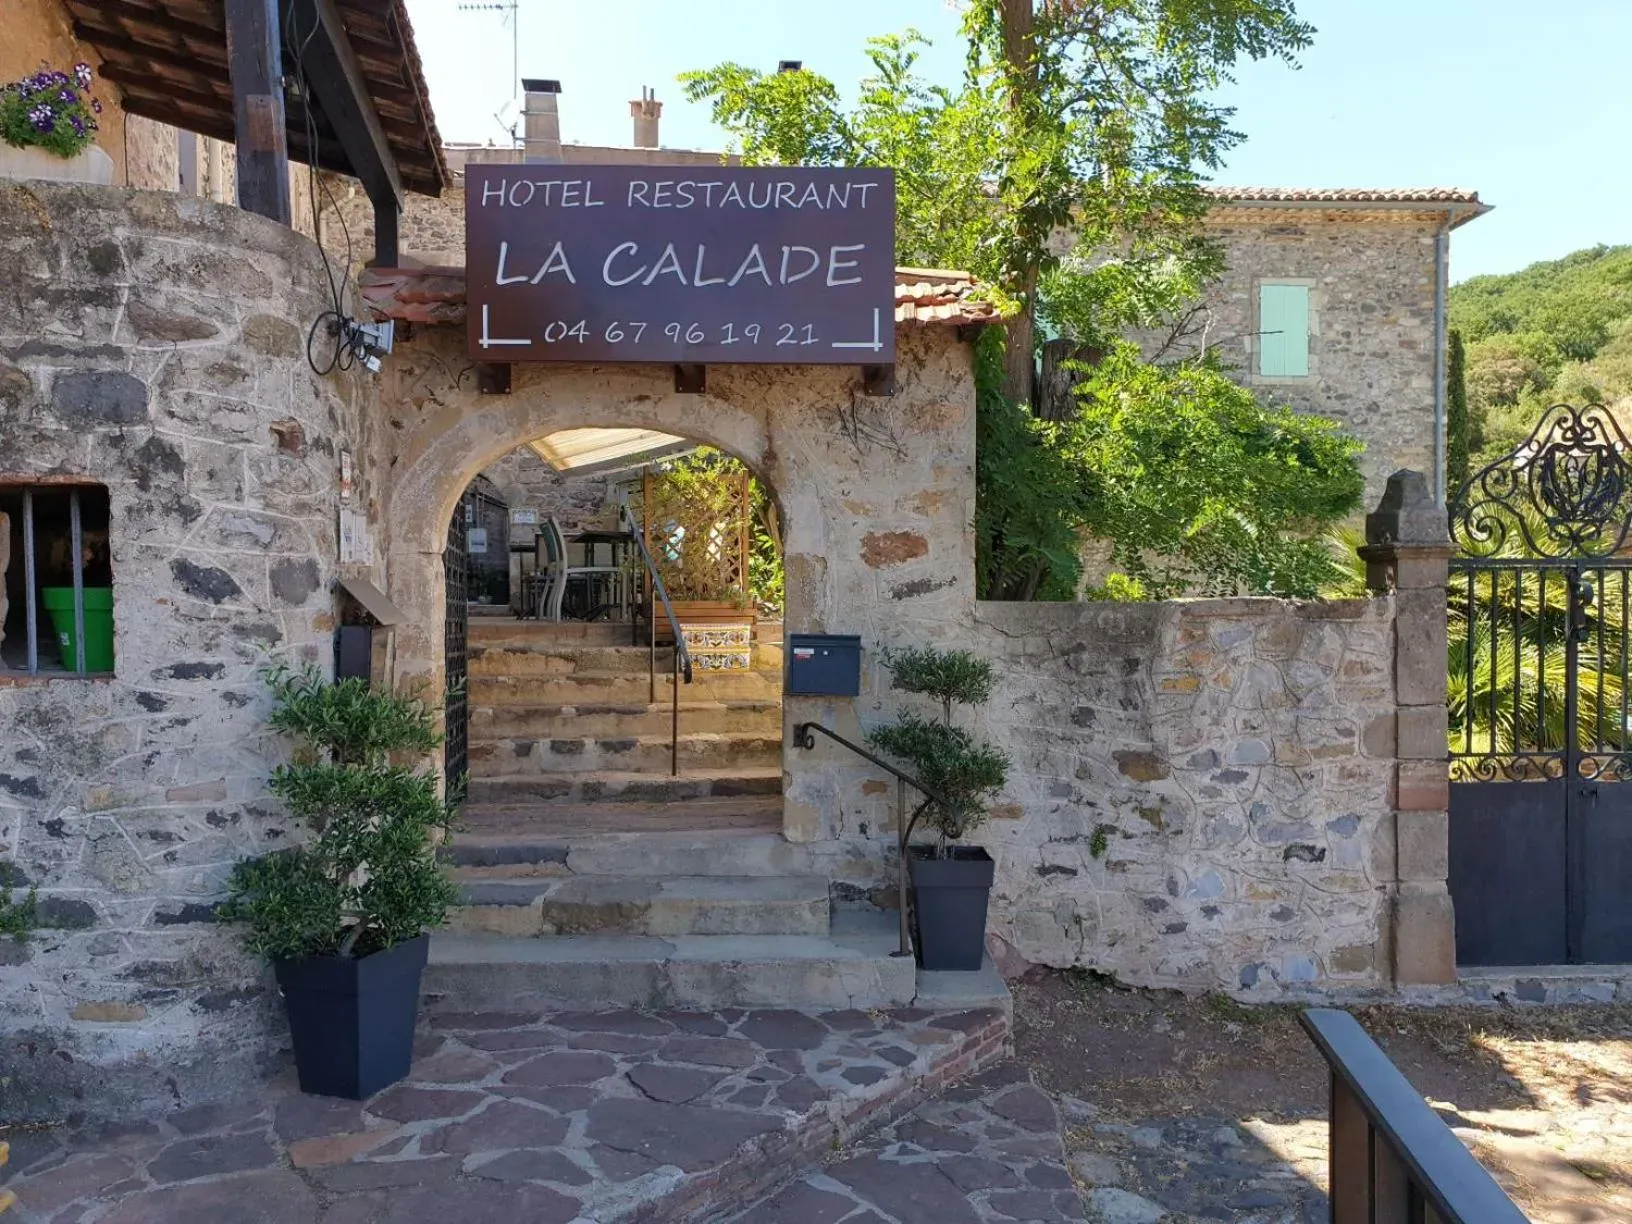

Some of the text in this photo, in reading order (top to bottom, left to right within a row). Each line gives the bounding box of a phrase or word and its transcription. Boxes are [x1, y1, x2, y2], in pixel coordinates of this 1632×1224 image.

[481, 179, 878, 210] HOTEL RESTAURANT
[495, 241, 865, 287] LA CALADE
[544, 320, 819, 347] 04 67 96 19 21
